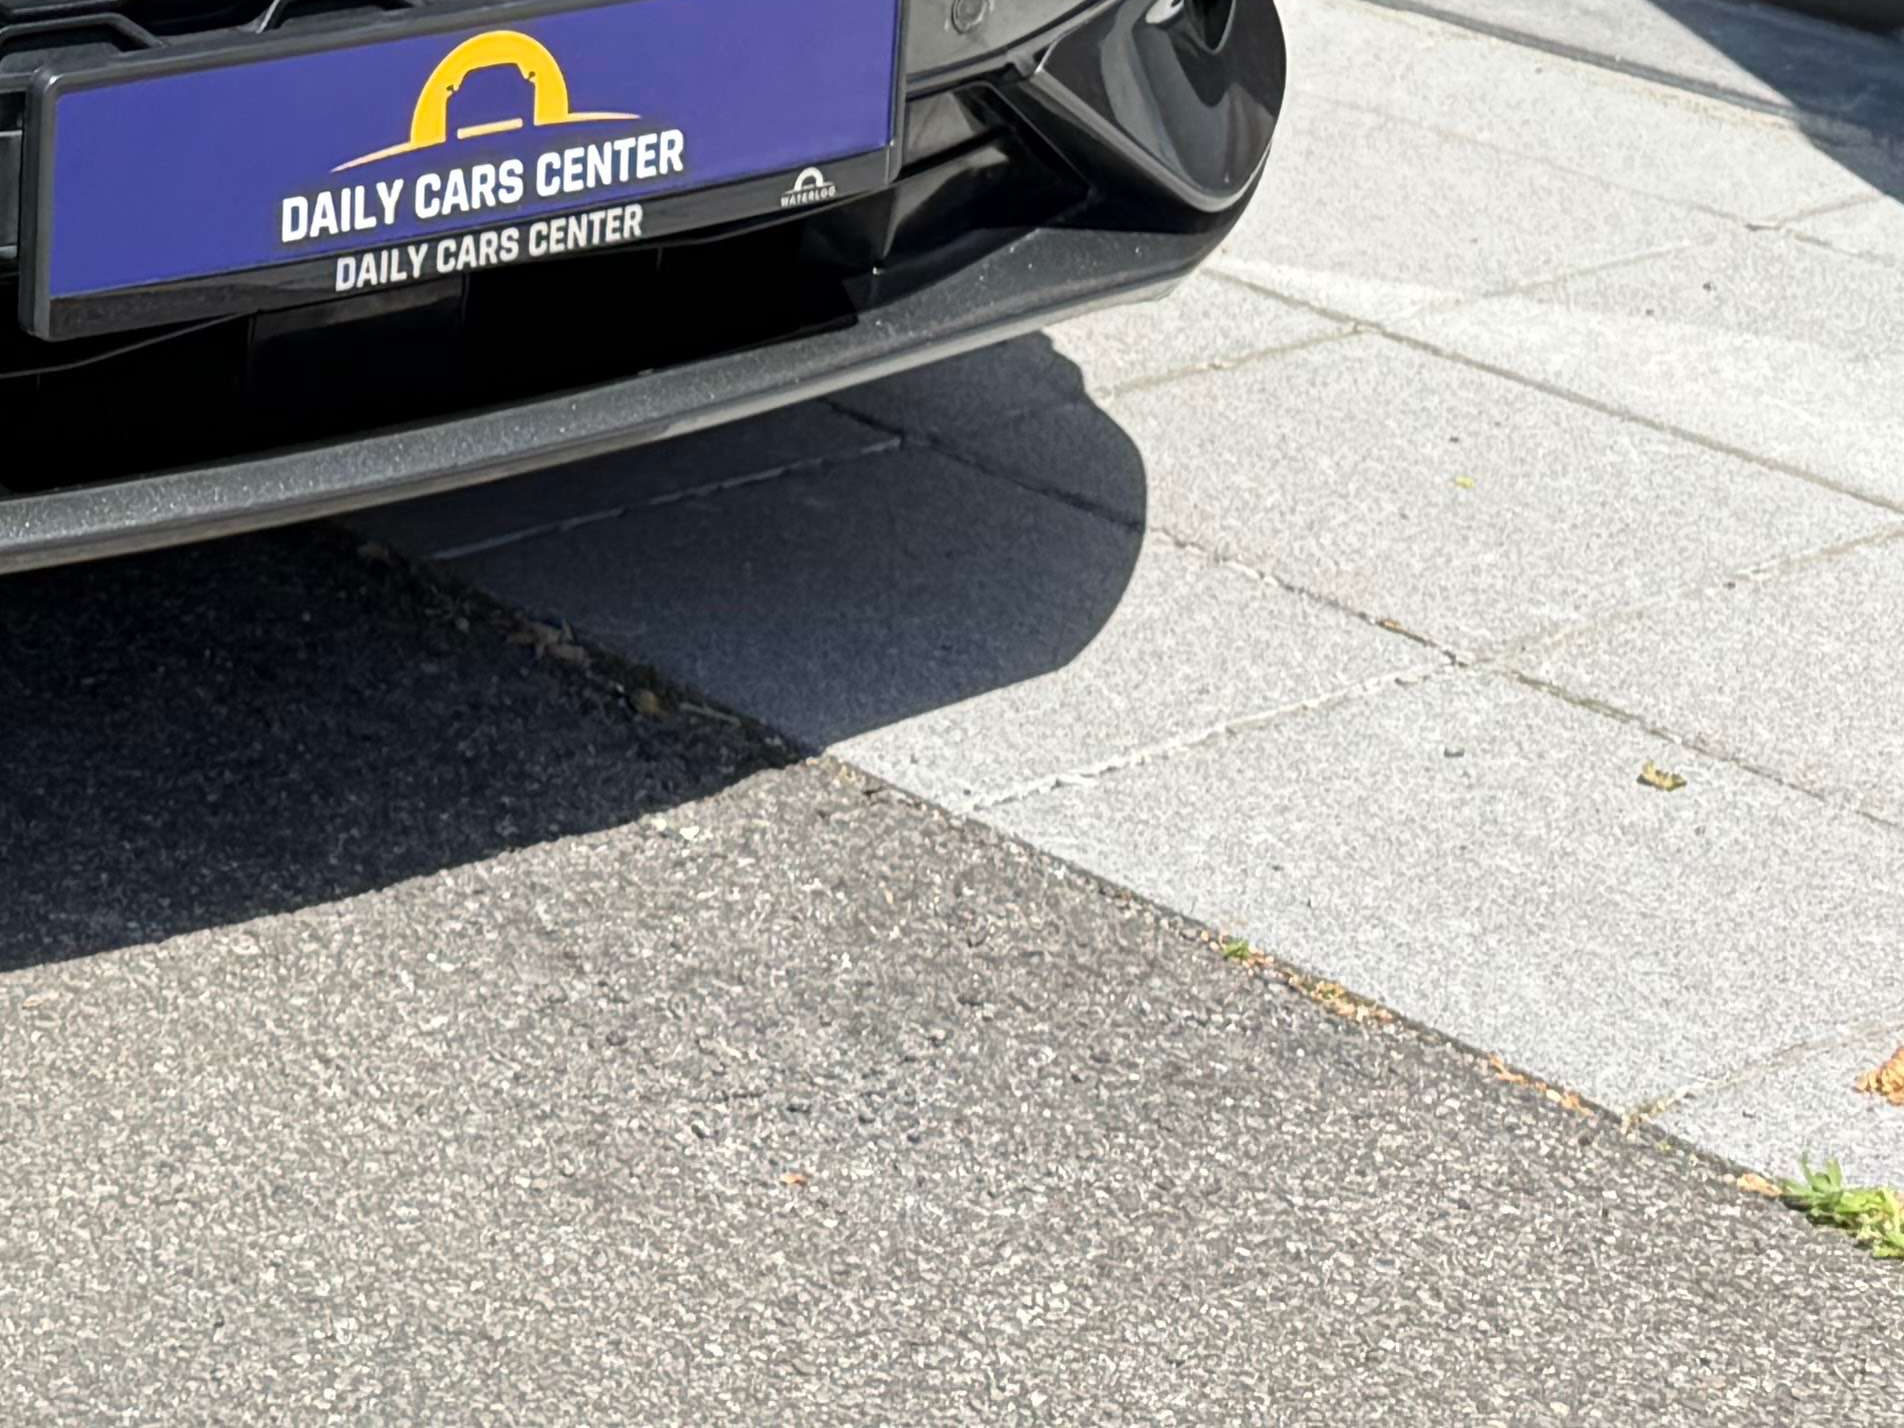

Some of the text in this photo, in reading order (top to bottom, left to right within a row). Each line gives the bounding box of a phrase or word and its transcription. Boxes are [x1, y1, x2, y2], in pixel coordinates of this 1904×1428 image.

[281, 128, 685, 244] DAILY CARS CENTER
[780, 185, 836, 208] WATERLOO
[335, 204, 643, 293] DAILY CARS CENTER
